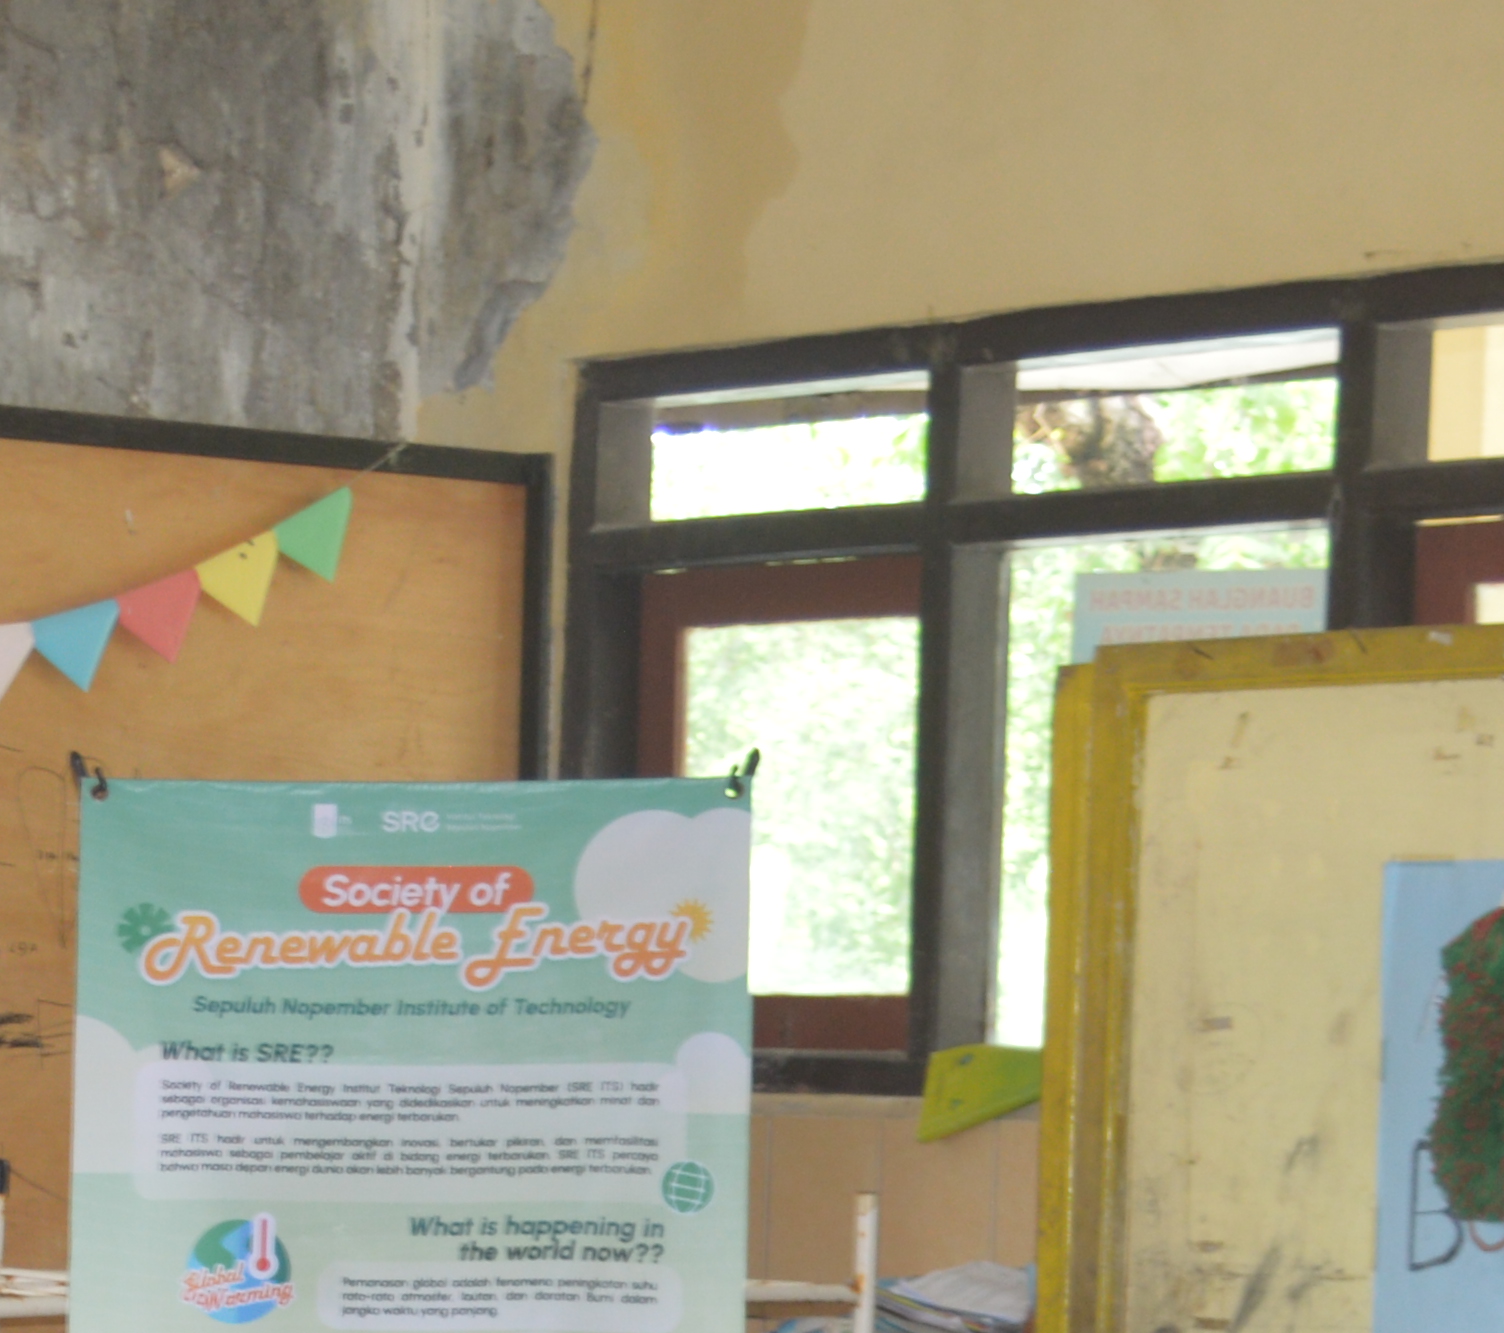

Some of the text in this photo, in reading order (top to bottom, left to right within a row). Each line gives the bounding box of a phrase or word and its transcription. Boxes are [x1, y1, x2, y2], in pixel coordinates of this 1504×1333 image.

[322, 872, 512, 916] Society of
[143, 906, 689, 989] Renewable Energy
[192, 996, 631, 1020] Sepuluh Nopember Institute of Technology
[160, 1041, 335, 1065] What is SRE??
[161, 1080, 202, 1092] Society
[210, 1081, 221, 1091] of
[228, 1081, 290, 1093] Renewable
[297, 1082, 335, 1096] Energy
[448, 1084, 493, 1095] Sepuluh
[500, 1084, 560, 1095] Nopember
[409, 1215, 665, 1243] What is happening in
[458, 1240, 665, 1263] the world now??
